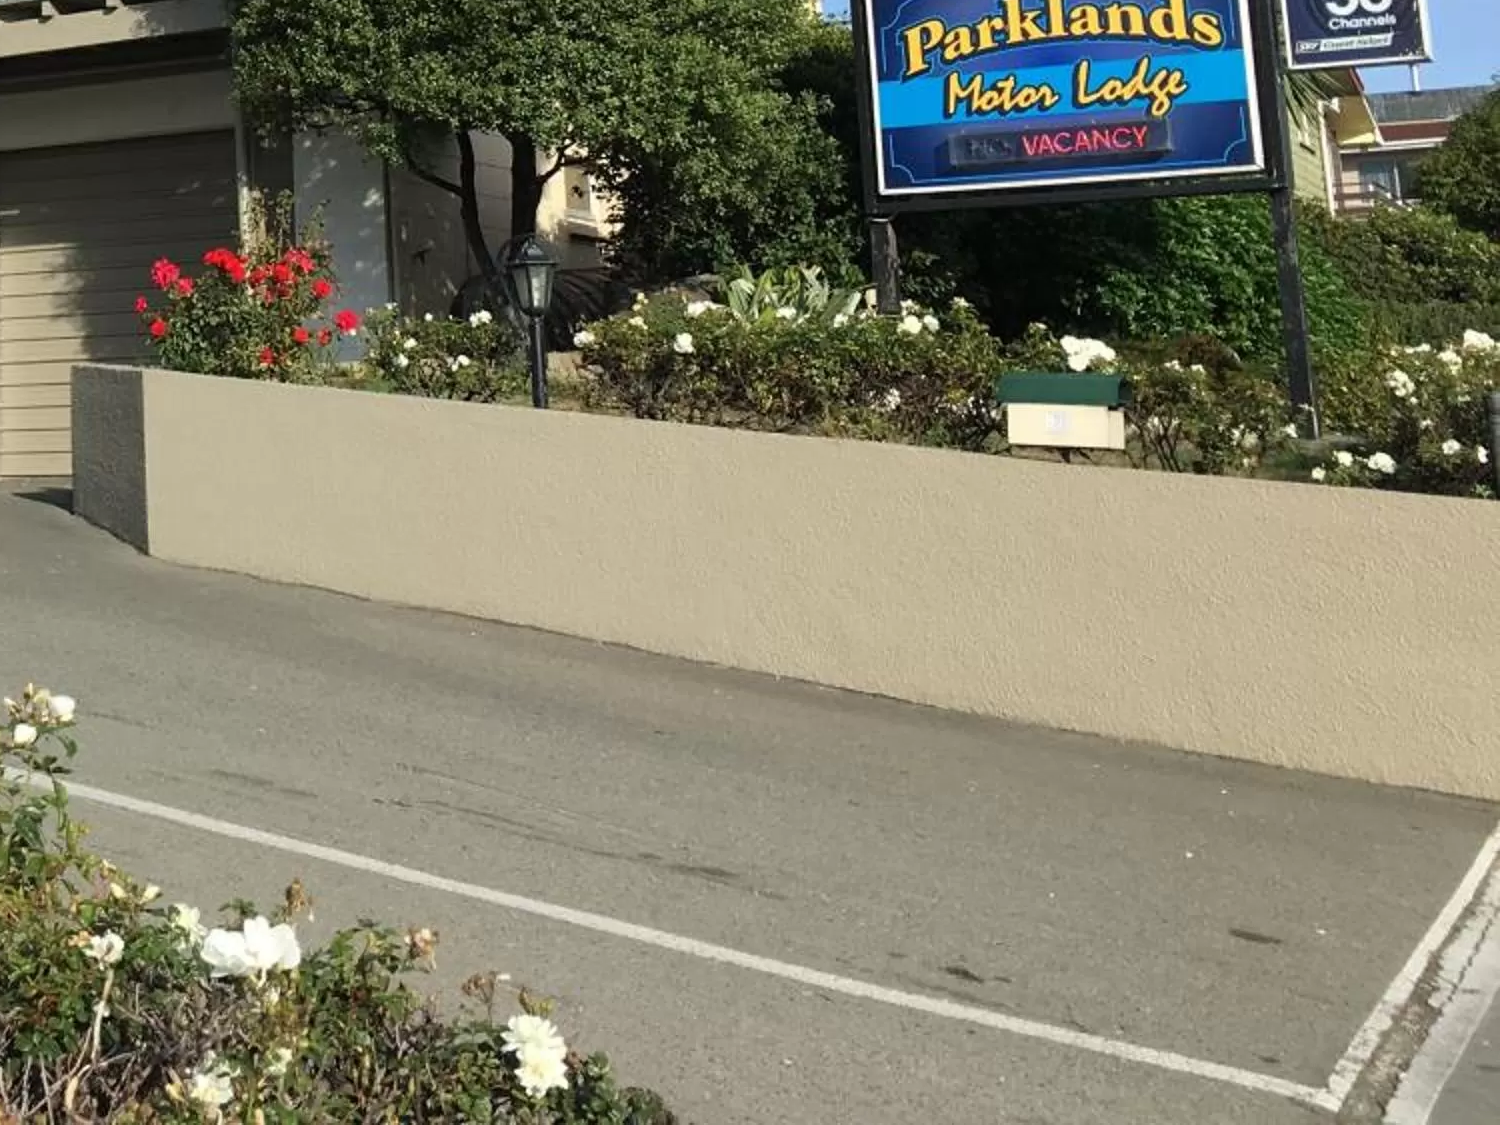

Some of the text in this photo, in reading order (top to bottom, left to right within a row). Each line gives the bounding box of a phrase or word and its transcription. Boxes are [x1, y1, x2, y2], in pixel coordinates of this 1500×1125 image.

[1329, 13, 1397, 30] Channels
[947, 56, 1188, 116] Motor Lodge
[1022, 125, 1148, 156] VACANCY
